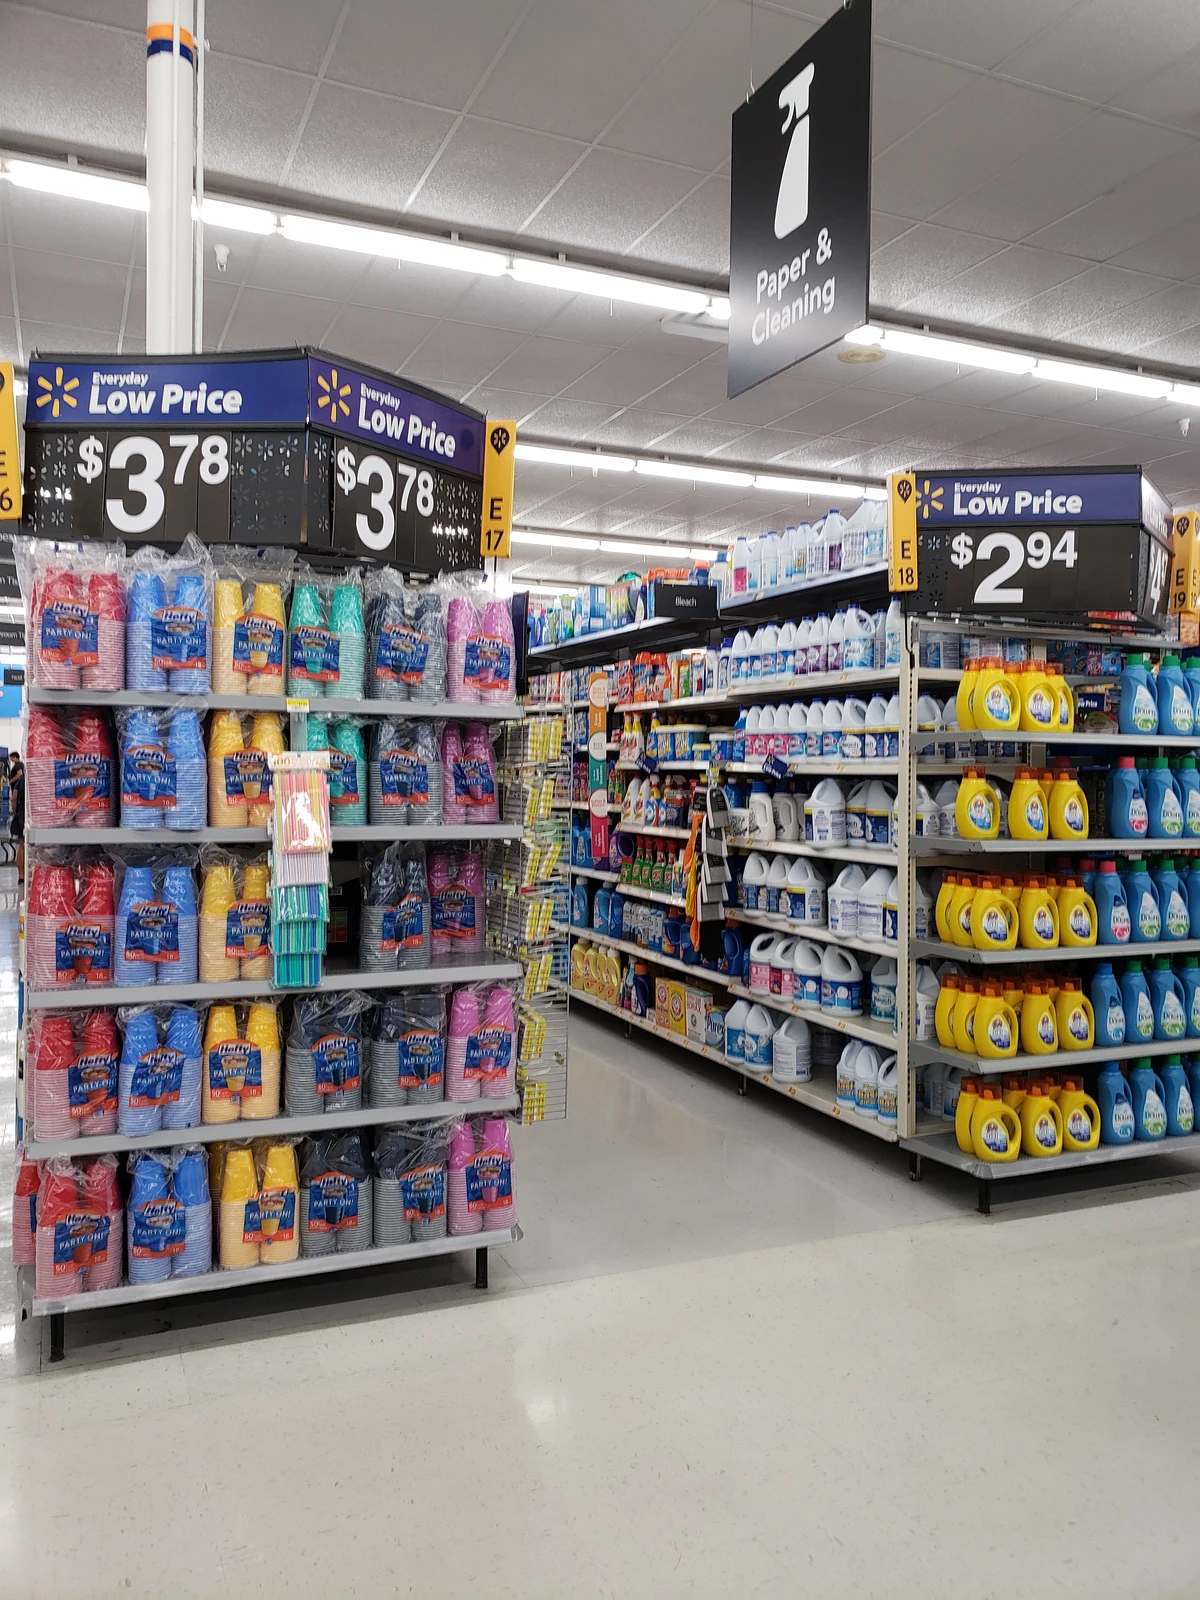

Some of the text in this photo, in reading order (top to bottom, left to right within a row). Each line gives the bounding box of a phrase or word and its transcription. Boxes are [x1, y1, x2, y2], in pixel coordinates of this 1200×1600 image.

[756, 227, 832, 304] Paper &
[751, 276, 835, 346] Cleaning
[92, 371, 148, 388] Everyday
[89, 383, 242, 414] Low Price
[360, 383, 400, 410] Everyday
[357, 405, 456, 459] Low Price
[954, 481, 1001, 494] Everyday
[953, 489, 1083, 516] Low Price
[489, 498, 502, 519] E
[485, 531, 503, 552] 17
[901, 540, 911, 560] E
[898, 567, 914, 585] 18
[1176, 568, 1185, 586] E
[675, 596, 697, 607] Bleach
[1173, 592, 1186, 609] 19
[45, 627, 73, 638] PARTY
[157, 637, 183, 645] PARTY
[238, 641, 262, 651] PARTY
[294, 651, 318, 659] PARTY
[381, 649, 404, 660] PARTY
[469, 658, 490, 668] PARTY
[126, 773, 152, 781] PARTY
[230, 775, 254, 784] PARTY
[385, 775, 409, 783] PARTY
[60, 778, 87, 787] PARTY
[435, 912, 455, 920] PARTY
[130, 930, 153, 938] PARTY
[231, 927, 257, 935] PARTY
[60, 948, 86, 958] PARTY
[470, 1049, 490, 1057] PARTY
[403, 1056, 425, 1066] PARTY
[320, 1062, 339, 1072] PARTY
[213, 1069, 238, 1078] PARTY
[137, 1076, 160, 1084] PARTY
[73, 1082, 99, 1093] PARTY
[470, 1181, 494, 1190] PARTY
[407, 1190, 428, 1199] PARTY
[313, 1199, 337, 1209] PARTY
[249, 1210, 272, 1220] PARTY
[137, 1229, 163, 1237] PARTY
[59, 1236, 85, 1250] PARTY
